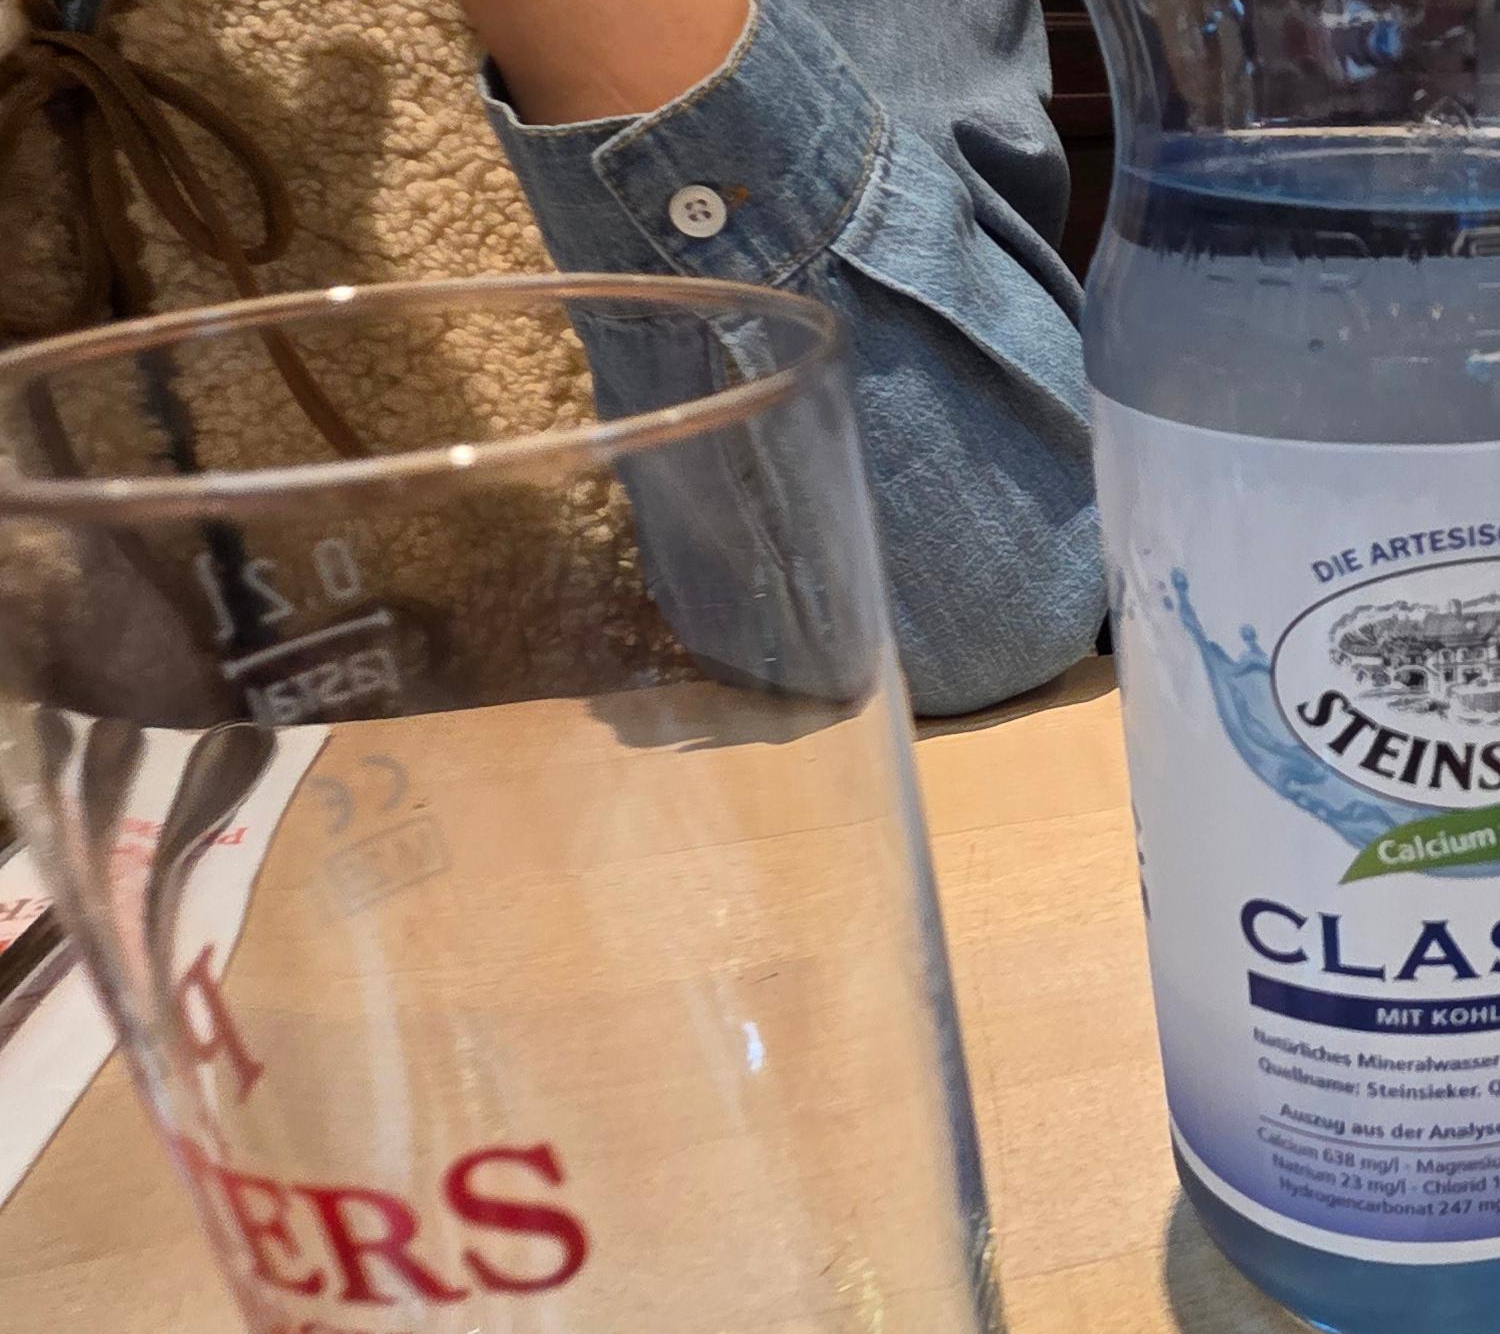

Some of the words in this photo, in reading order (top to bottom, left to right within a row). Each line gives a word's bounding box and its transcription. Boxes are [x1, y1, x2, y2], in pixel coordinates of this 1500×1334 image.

[1312, 551, 1362, 585] DIE
[1376, 822, 1496, 866] Calcium
[1376, 1007, 1424, 1027] MIT
[1357, 1052, 1500, 1072] Mineralwasser
[1279, 1102, 1346, 1137] Auszug
[1352, 1120, 1386, 1140] aus
[1391, 1121, 1426, 1141] der
[1438, 1198, 1473, 1217] 247
